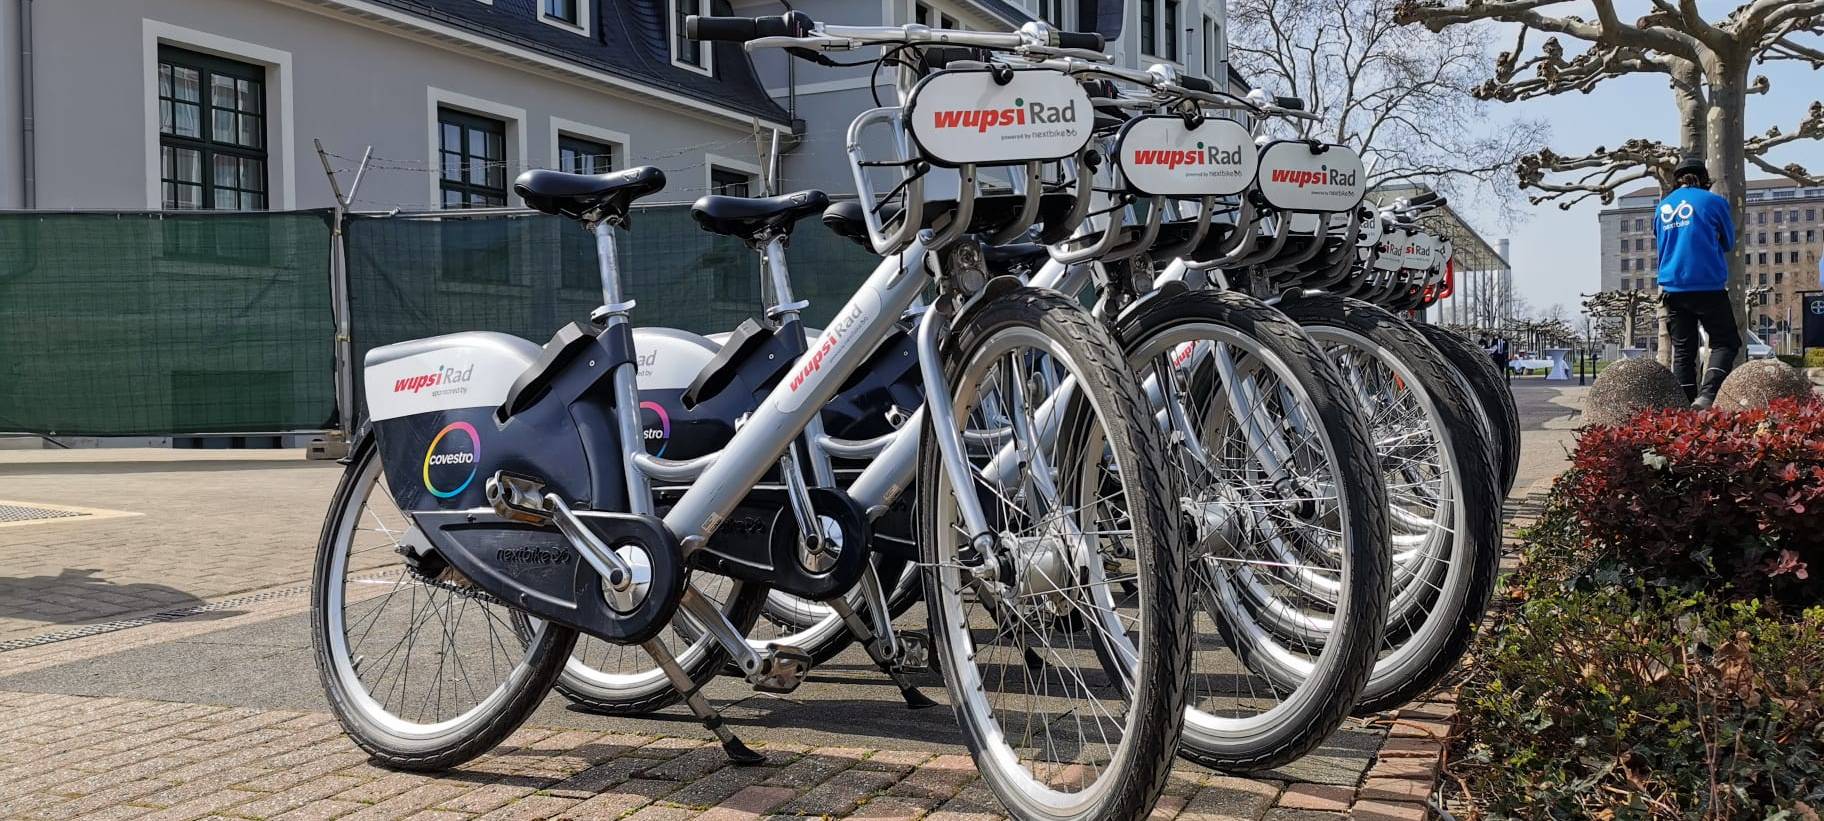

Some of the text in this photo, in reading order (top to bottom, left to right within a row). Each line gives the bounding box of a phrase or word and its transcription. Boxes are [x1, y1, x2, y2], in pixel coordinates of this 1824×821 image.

[934, 98, 1076, 133] wupsi Rad
[1032, 129, 1065, 138] nextbike
[1134, 141, 1242, 170] wupsi Rad
[1271, 164, 1356, 188] wupsi Rad
[638, 350, 657, 366] ad
[790, 333, 837, 391] wupsi
[834, 304, 863, 337] Rad
[394, 364, 474, 393] wupsi Rad
[643, 428, 663, 440] stro
[429, 451, 473, 465] covestro
[497, 546, 551, 564] nextbike
